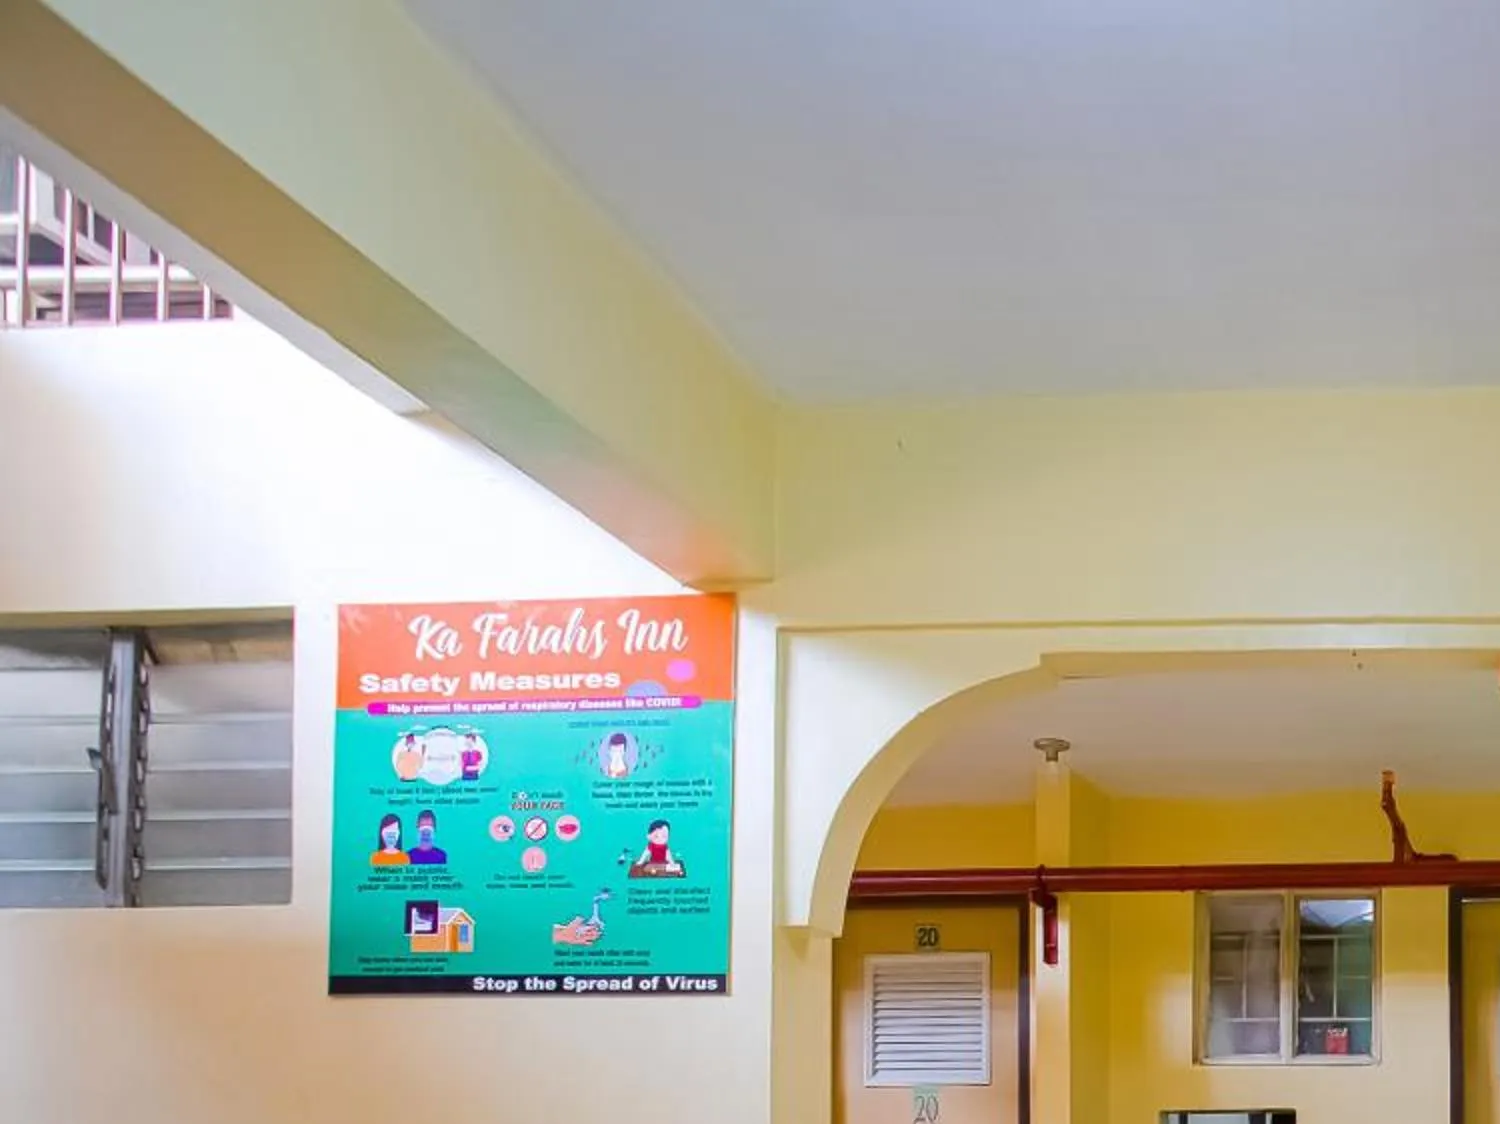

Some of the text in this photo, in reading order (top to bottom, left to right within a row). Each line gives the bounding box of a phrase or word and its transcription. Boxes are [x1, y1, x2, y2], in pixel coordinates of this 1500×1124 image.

[408, 606, 689, 661] Ka Farahs Inn
[359, 671, 621, 697] Safety Measures
[387, 703, 410, 714] Help
[453, 702, 469, 713] the
[471, 701, 506, 713] spread
[917, 926, 940, 947] 20
[472, 975, 719, 993] Stop the Spread of Virus
